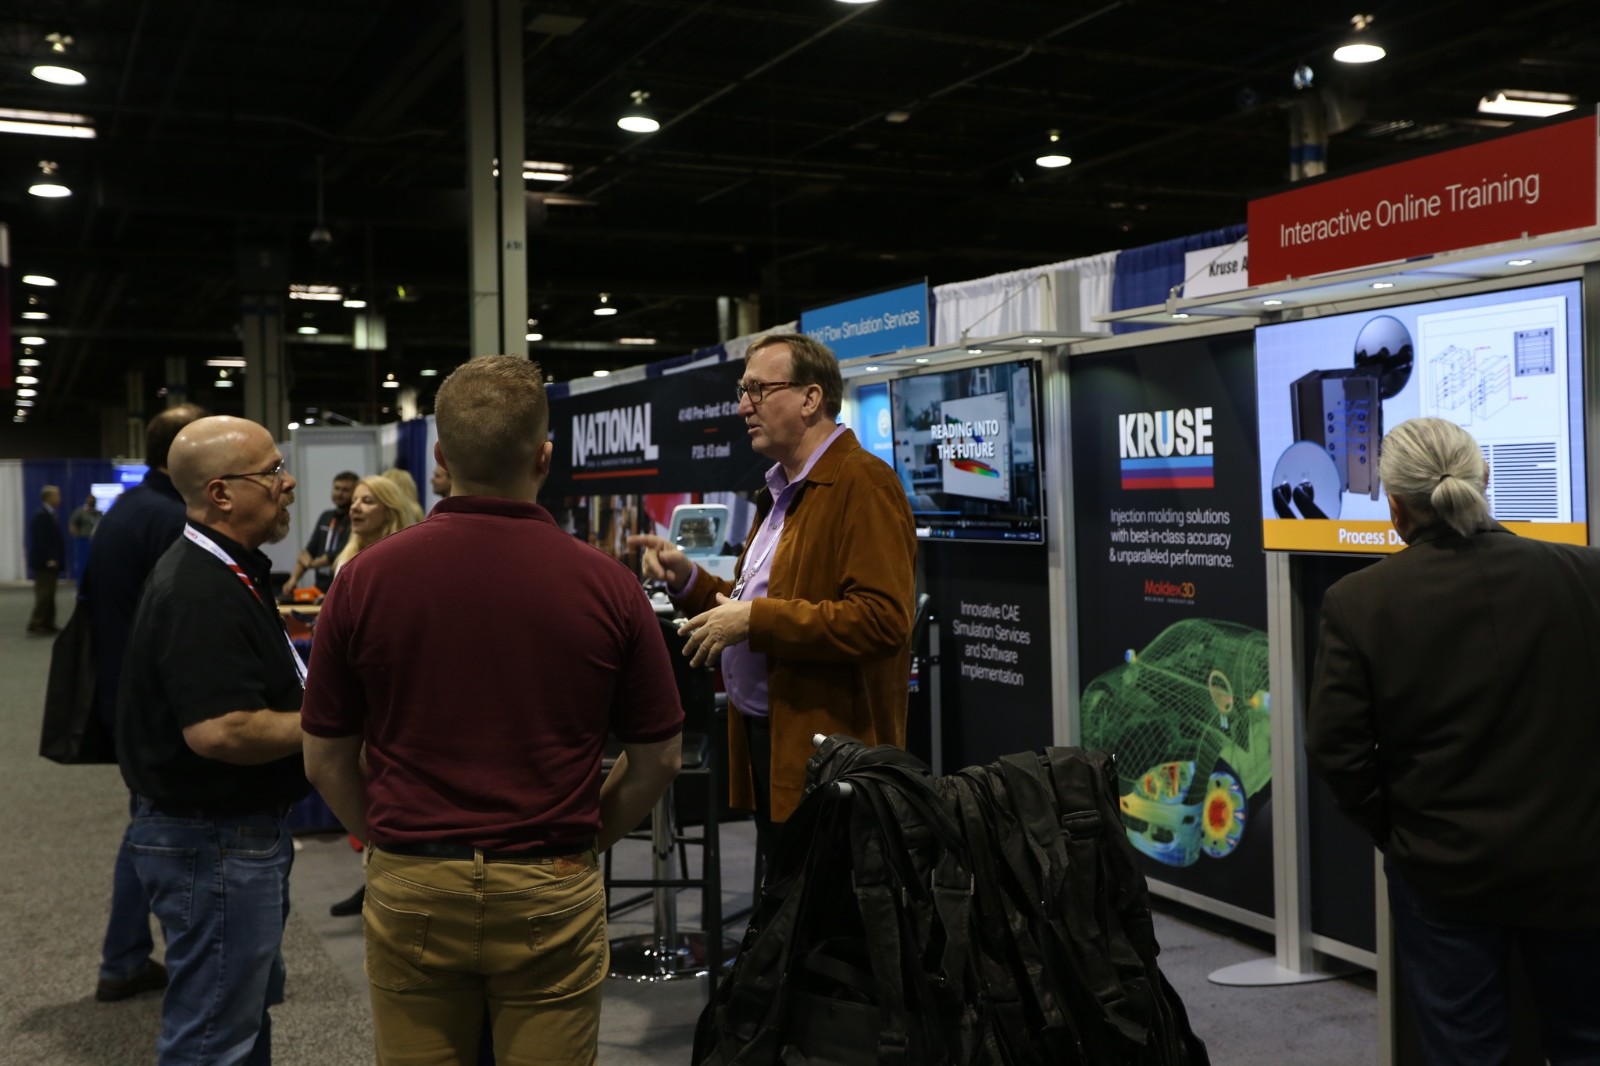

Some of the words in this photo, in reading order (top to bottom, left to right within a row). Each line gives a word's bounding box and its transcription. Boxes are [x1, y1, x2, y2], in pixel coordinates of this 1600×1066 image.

[1281, 209, 1372, 248] Interactive
[1376, 194, 1441, 227] Online
[1445, 173, 1540, 212] Training
[1209, 260, 1238, 277] Kruse
[825, 325, 841, 341] Flow
[841, 316, 883, 339] Simulation
[883, 309, 920, 330] Services
[572, 402, 659, 467] NATIONAL
[931, 422, 973, 440] READING
[974, 420, 999, 436] INTO
[1119, 407, 1213, 458] KRUSE
[937, 444, 956, 460] THE
[957, 442, 995, 459] FUTURE
[1110, 508, 1146, 526] Injection
[1147, 508, 1184, 527] molding
[1186, 508, 1230, 524] solutions
[1110, 528, 1129, 542] with
[1130, 528, 1185, 544] best-in-class
[1187, 532, 1231, 550] accuracy
[1338, 527, 1385, 545] Process
[1109, 547, 1116, 562] &
[1117, 548, 1168, 565] unparalleled
[1170, 549, 1234, 568] performance.
[1144, 580, 1195, 598] Moldex3D
[960, 600, 1001, 619] Innovative
[1002, 604, 1020, 622] CAE
[953, 619, 994, 639] Simulation
[995, 624, 1031, 644] Services
[965, 642, 980, 658] and
[981, 643, 1018, 664] Software
[961, 661, 1024, 686] Implementation
